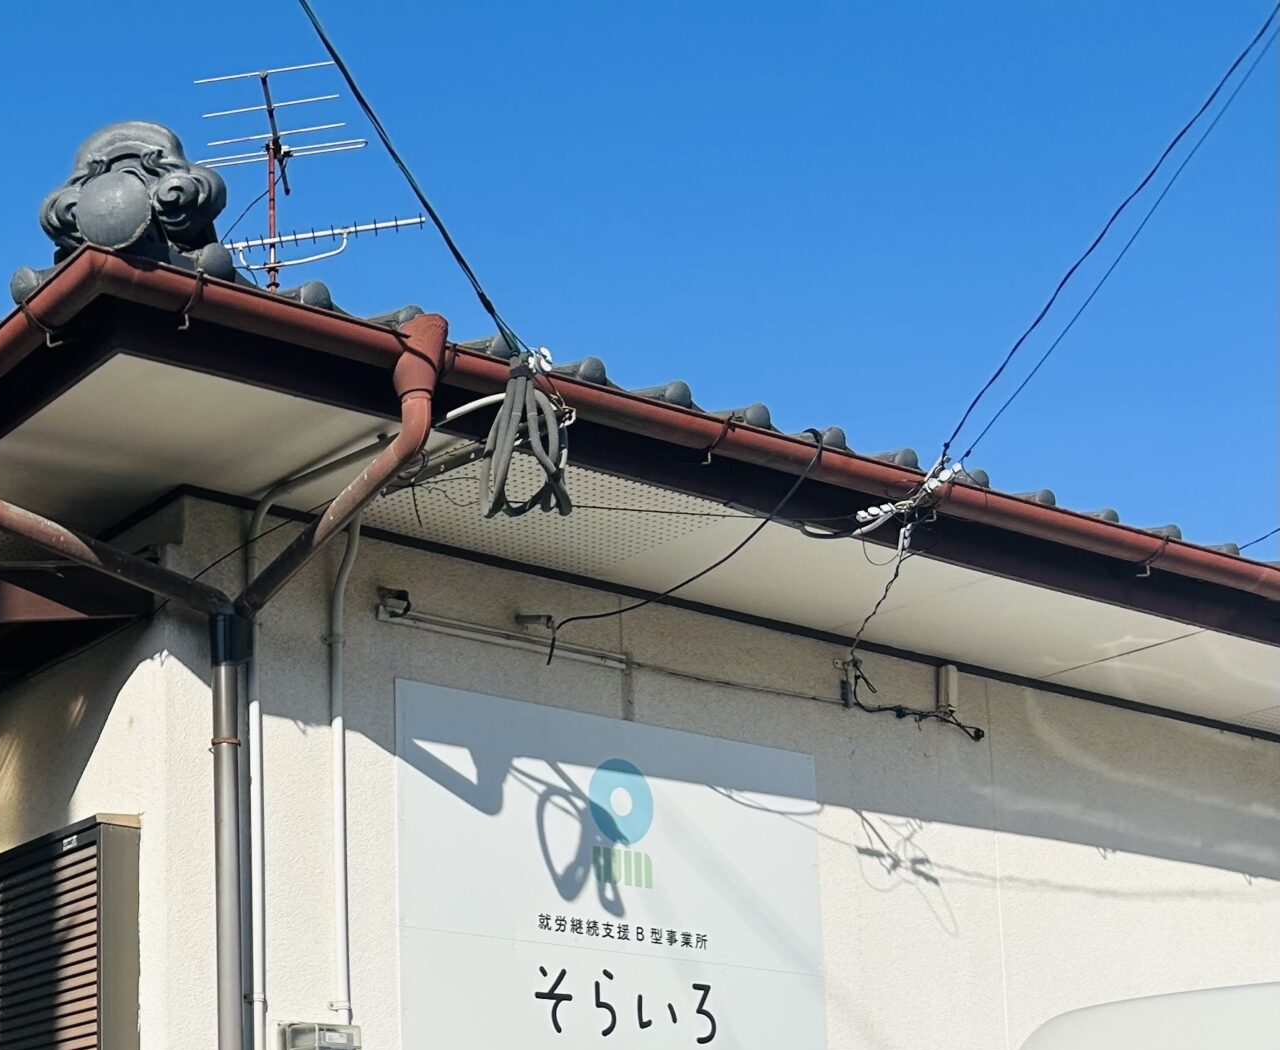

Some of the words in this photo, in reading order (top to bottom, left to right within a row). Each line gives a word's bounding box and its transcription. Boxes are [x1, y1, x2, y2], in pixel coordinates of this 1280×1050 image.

[538, 913, 708, 950] 就労継続支援B型事業所
[534, 965, 717, 1045] そらいろ
